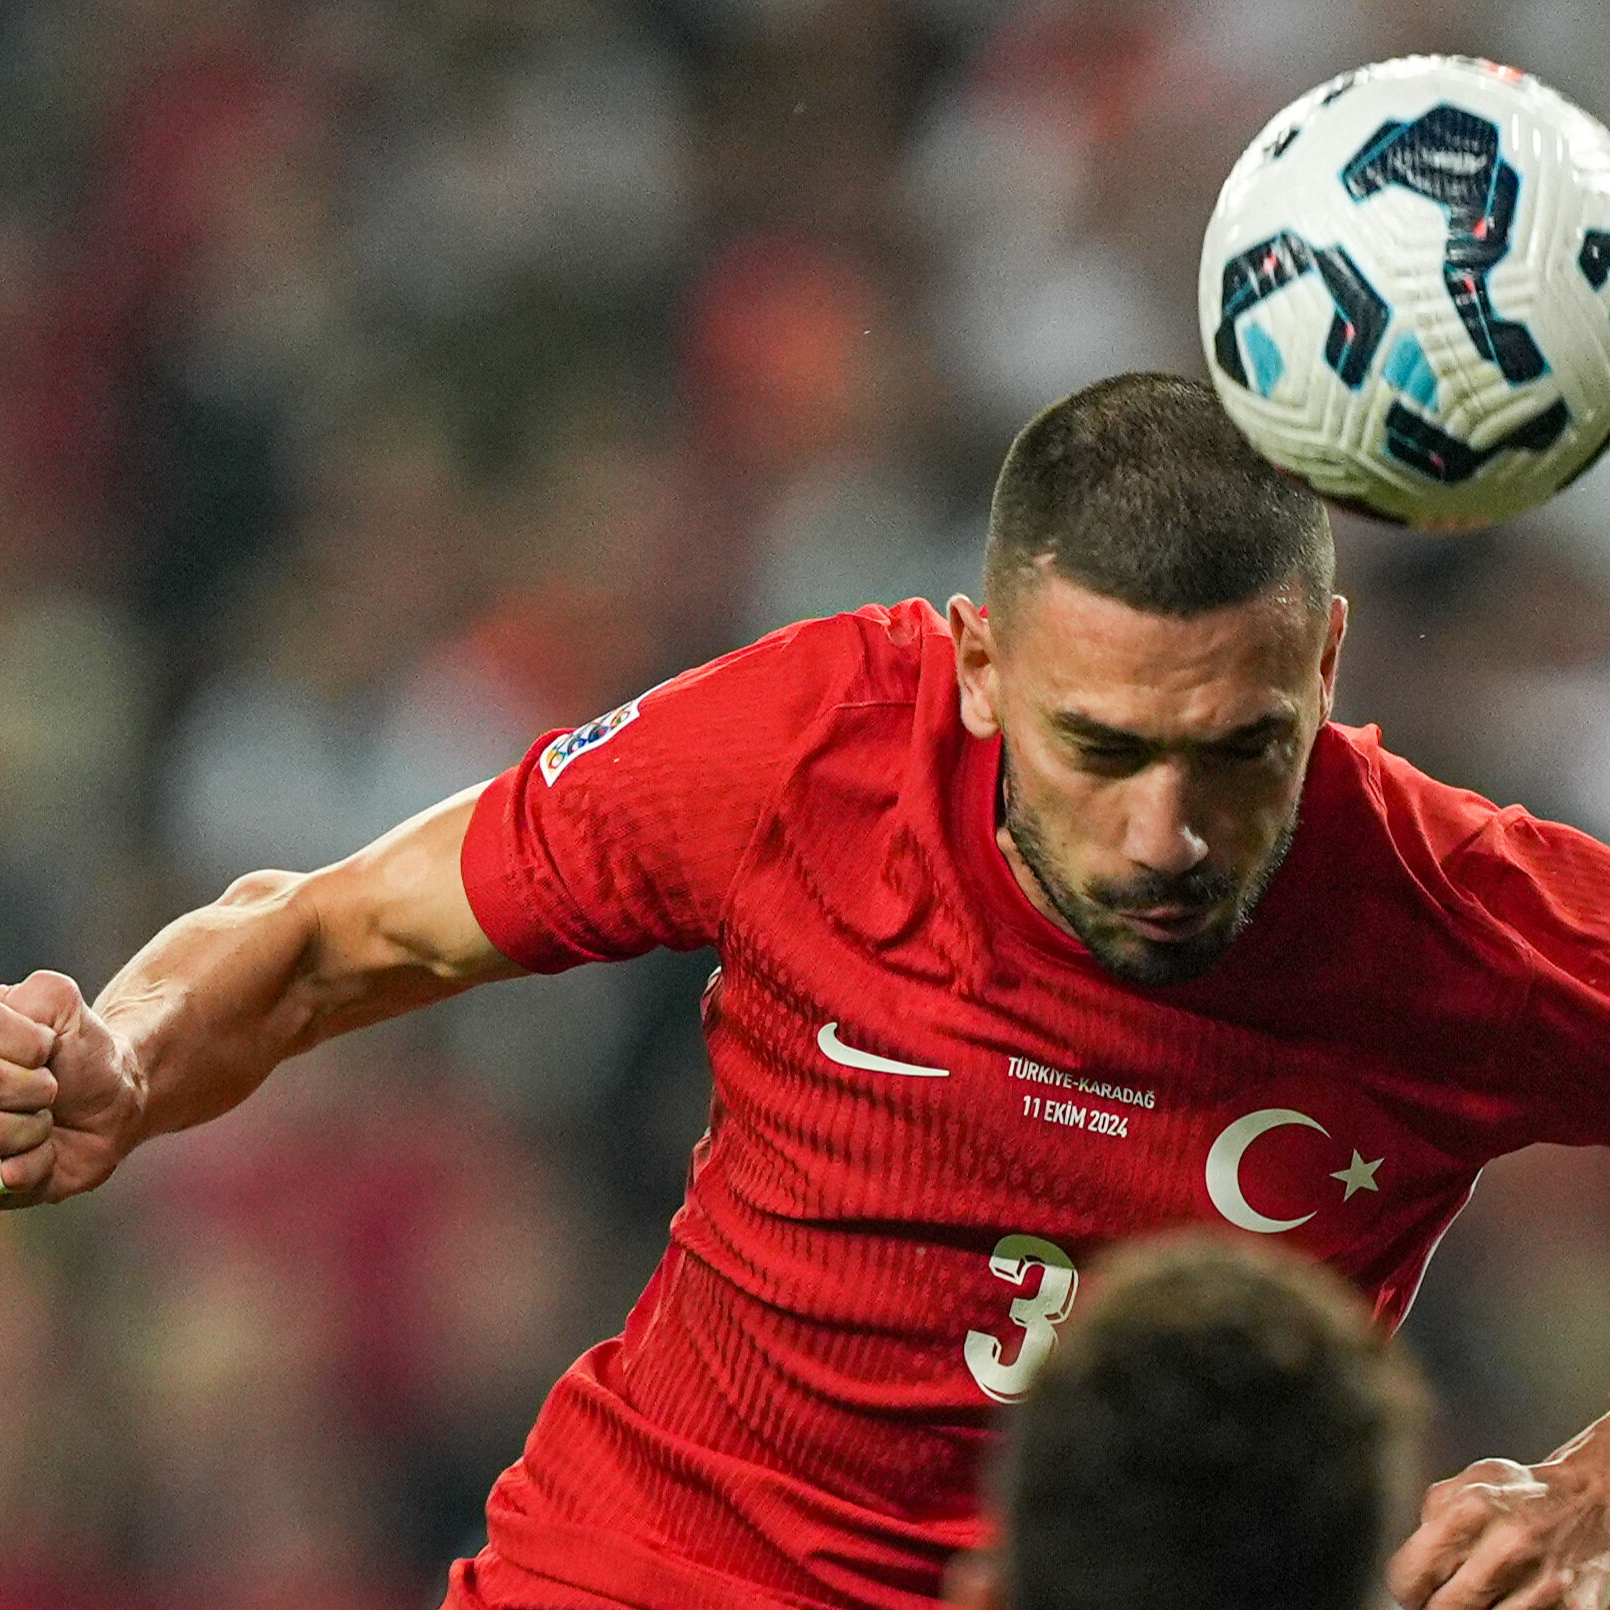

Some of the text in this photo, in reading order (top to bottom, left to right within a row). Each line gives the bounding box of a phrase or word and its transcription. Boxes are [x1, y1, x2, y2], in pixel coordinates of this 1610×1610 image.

[1023, 1095, 1129, 1138] 11 EKİM 2024
[964, 1234, 1079, 1404] 3
